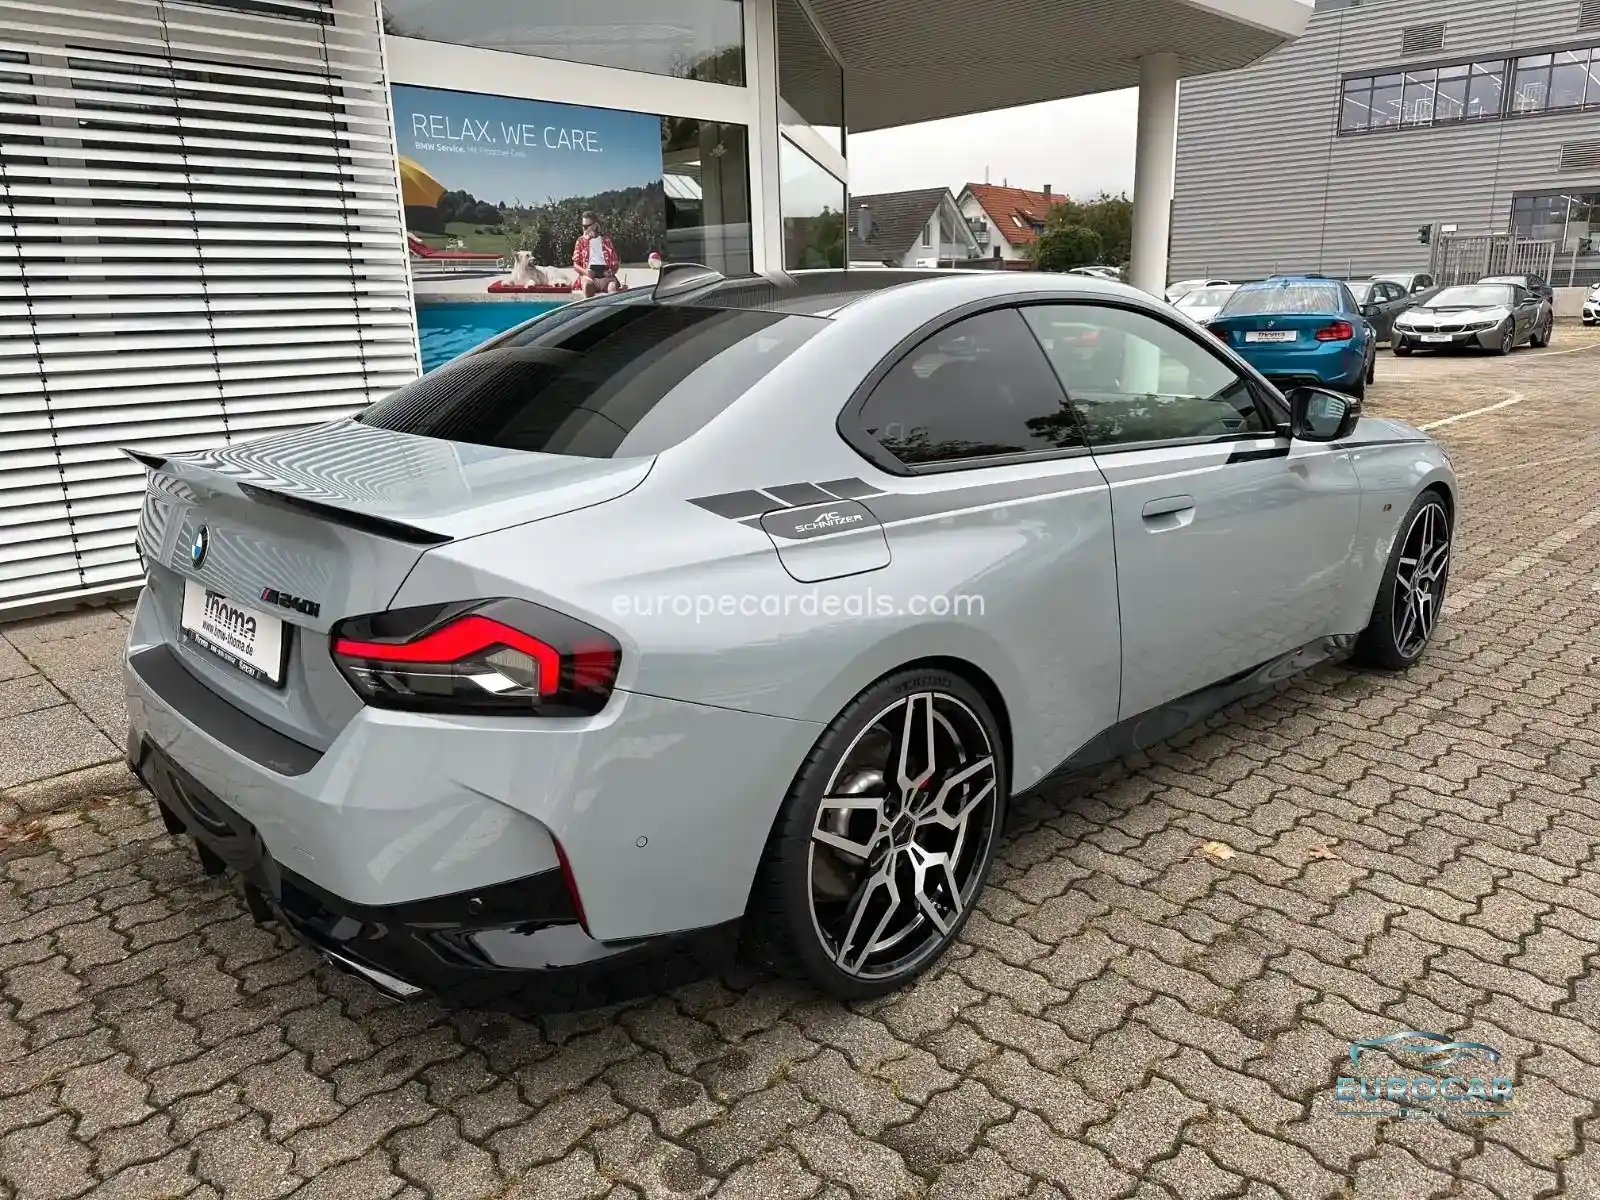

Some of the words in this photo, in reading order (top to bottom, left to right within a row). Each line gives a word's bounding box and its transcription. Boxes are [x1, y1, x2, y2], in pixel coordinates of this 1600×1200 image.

[415, 141, 435, 151] BMW
[436, 143, 466, 153] Service.
[501, 122, 537, 147] WE
[544, 126, 603, 153] CARE.
[795, 514, 864, 533] SCHNITZER
[814, 511, 840, 523] AC
[204, 588, 257, 642] Thoma
